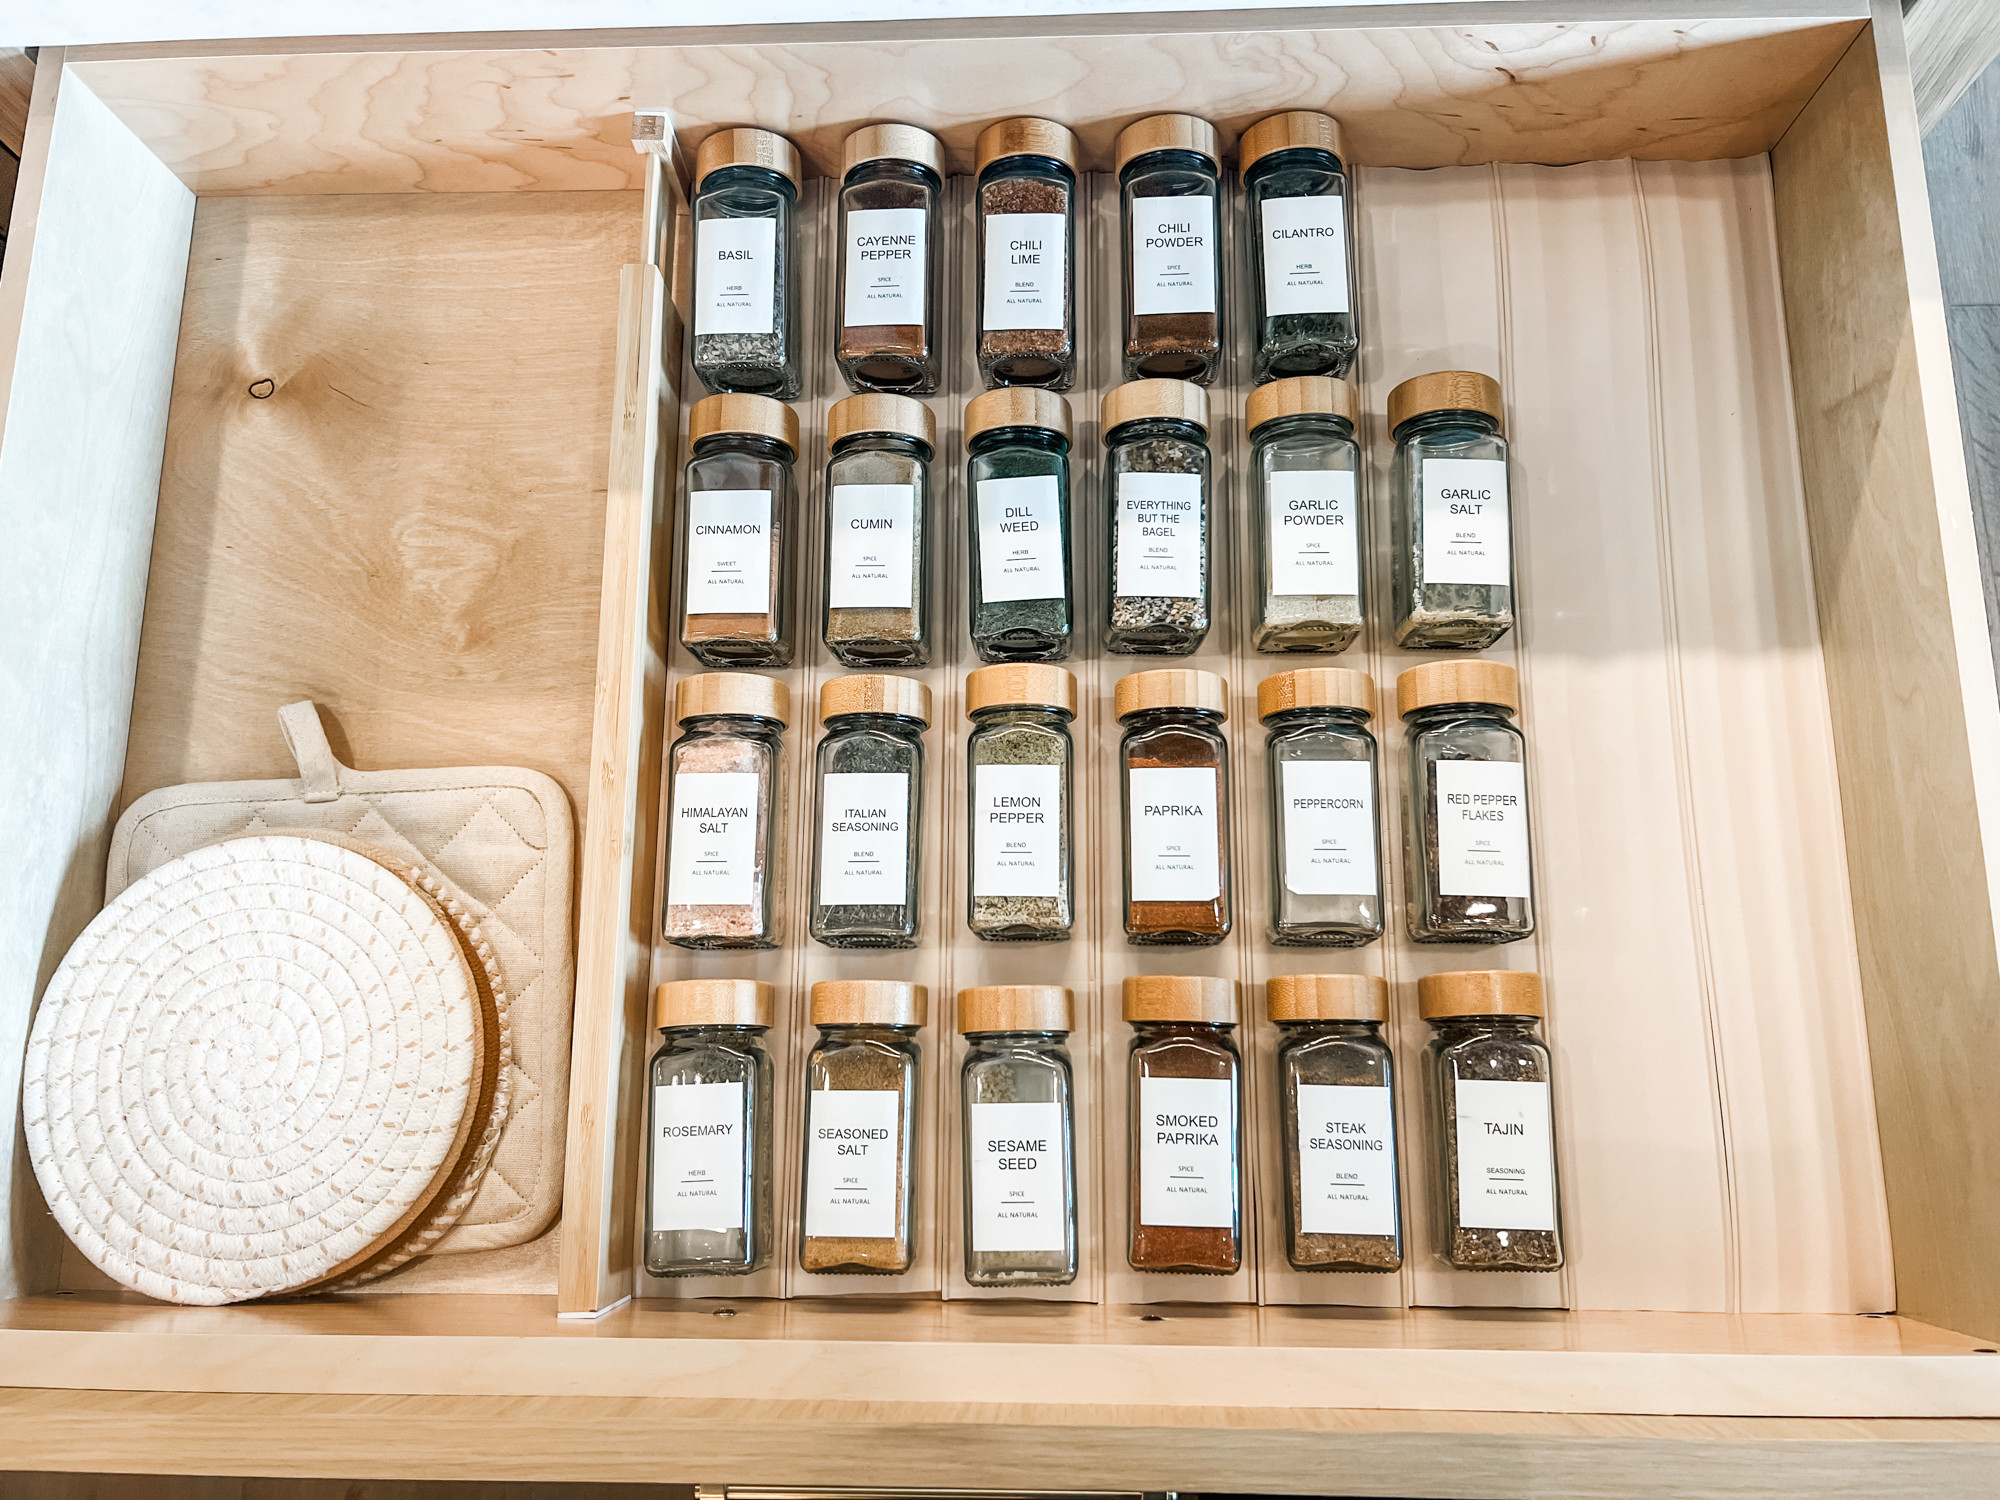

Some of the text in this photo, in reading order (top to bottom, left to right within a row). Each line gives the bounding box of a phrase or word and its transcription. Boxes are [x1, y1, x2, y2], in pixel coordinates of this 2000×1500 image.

[1158, 223, 1190, 234] CHILI
[1272, 227, 1334, 239] CILANTRO
[857, 235, 916, 246] CAYENNE
[1010, 240, 1042, 250] CHILI
[1146, 237, 1203, 248] POWDER
[719, 250, 753, 260] BASIL
[861, 249, 911, 260] PEPPER
[1011, 254, 1040, 264] LIME
[1441, 489, 1491, 500] GARLIC
[1127, 500, 1191, 510] EVERYTHING
[1289, 500, 1338, 510] GARLIC
[1450, 504, 1483, 514] SALT
[1006, 506, 1033, 518] DILL
[851, 519, 892, 529] CUMIN
[1138, 514, 1180, 523] BUT THE
[1284, 515, 1344, 525] POWDER
[696, 525, 760, 535] CINNAMON
[1000, 521, 1039, 533] WEED
[1143, 527, 1175, 536] BAGEL
[994, 797, 1040, 807] LEMON
[1294, 799, 1363, 809] PEPPERCORN
[1447, 794, 1517, 806] RED PEPPER
[682, 807, 748, 818] HIMALAYAN
[845, 809, 886, 818] ITALIAN
[1145, 805, 1203, 816] PAPRIKA
[1462, 810, 1504, 821] FLAKES
[990, 813, 1044, 823] PEPPER
[699, 823, 728, 833] SALT
[832, 822, 898, 832] SEASONING
[1156, 1114, 1218, 1127] SMOKED
[663, 1124, 733, 1137] ROSEMARY
[818, 1128, 888, 1139] SEASONED
[1326, 1122, 1366, 1134] STEAK
[1484, 1122, 1523, 1135] TAJIN
[1157, 1132, 1219, 1145] PAPRIKA
[837, 1144, 868, 1155] SALT
[988, 1140, 1047, 1152] SESAME
[1310, 1138, 1383, 1151] SEASONING
[998, 1158, 1037, 1170] SEED
